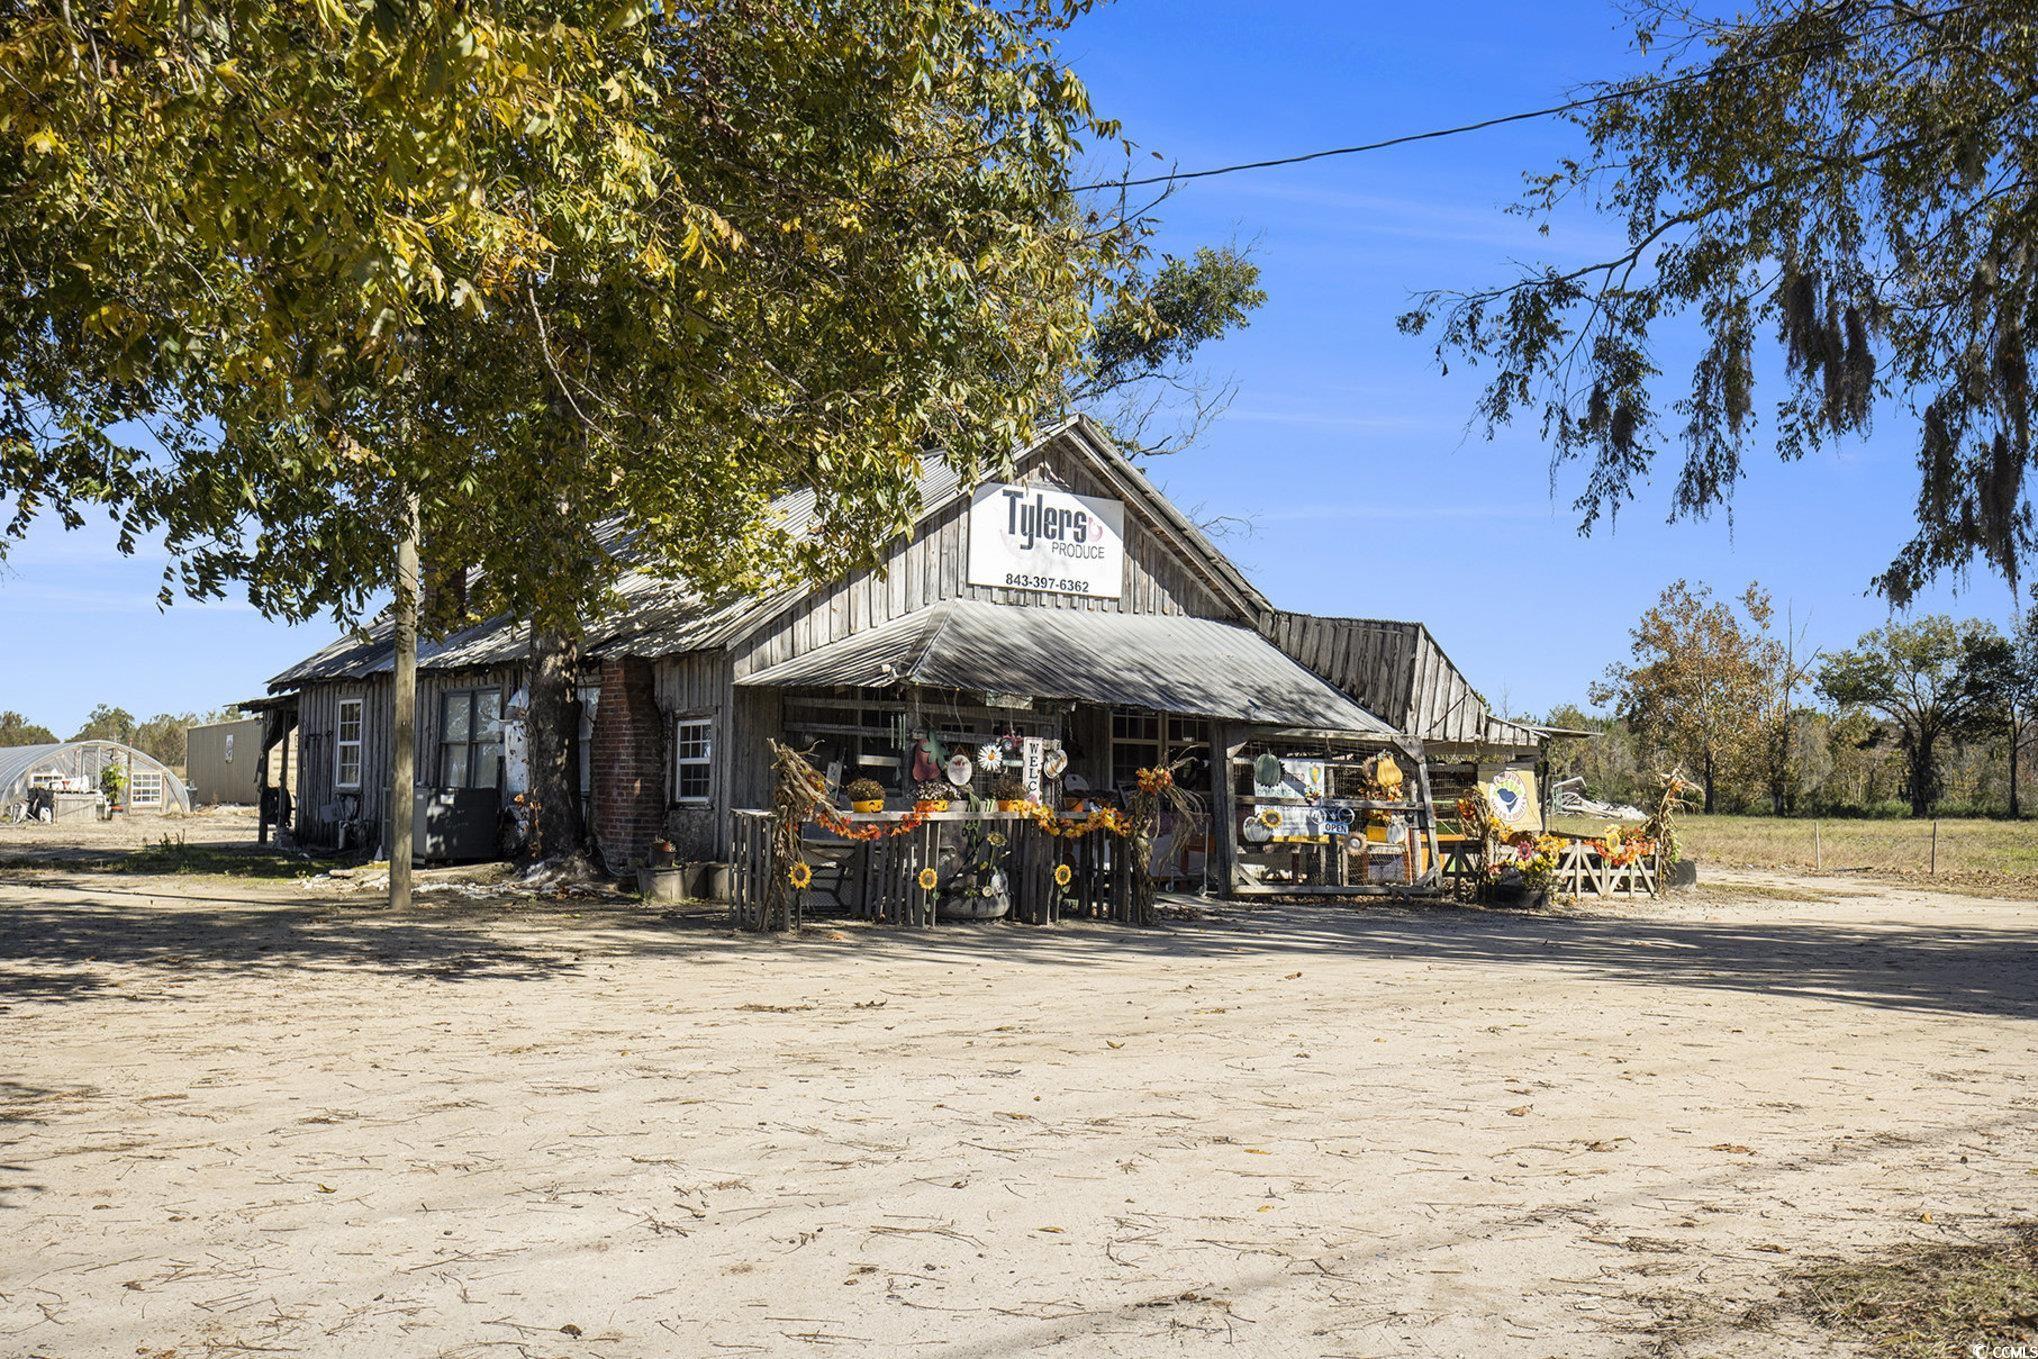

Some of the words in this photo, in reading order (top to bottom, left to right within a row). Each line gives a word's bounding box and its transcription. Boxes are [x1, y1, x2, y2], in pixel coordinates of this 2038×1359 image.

[1002, 489, 1087, 550] Tylers
[1051, 541, 1105, 560] PRODUCE
[1005, 573, 1089, 593] 843-397-6362
[1028, 742, 1039, 792] WELC
[1325, 823, 1347, 833] OPEN
